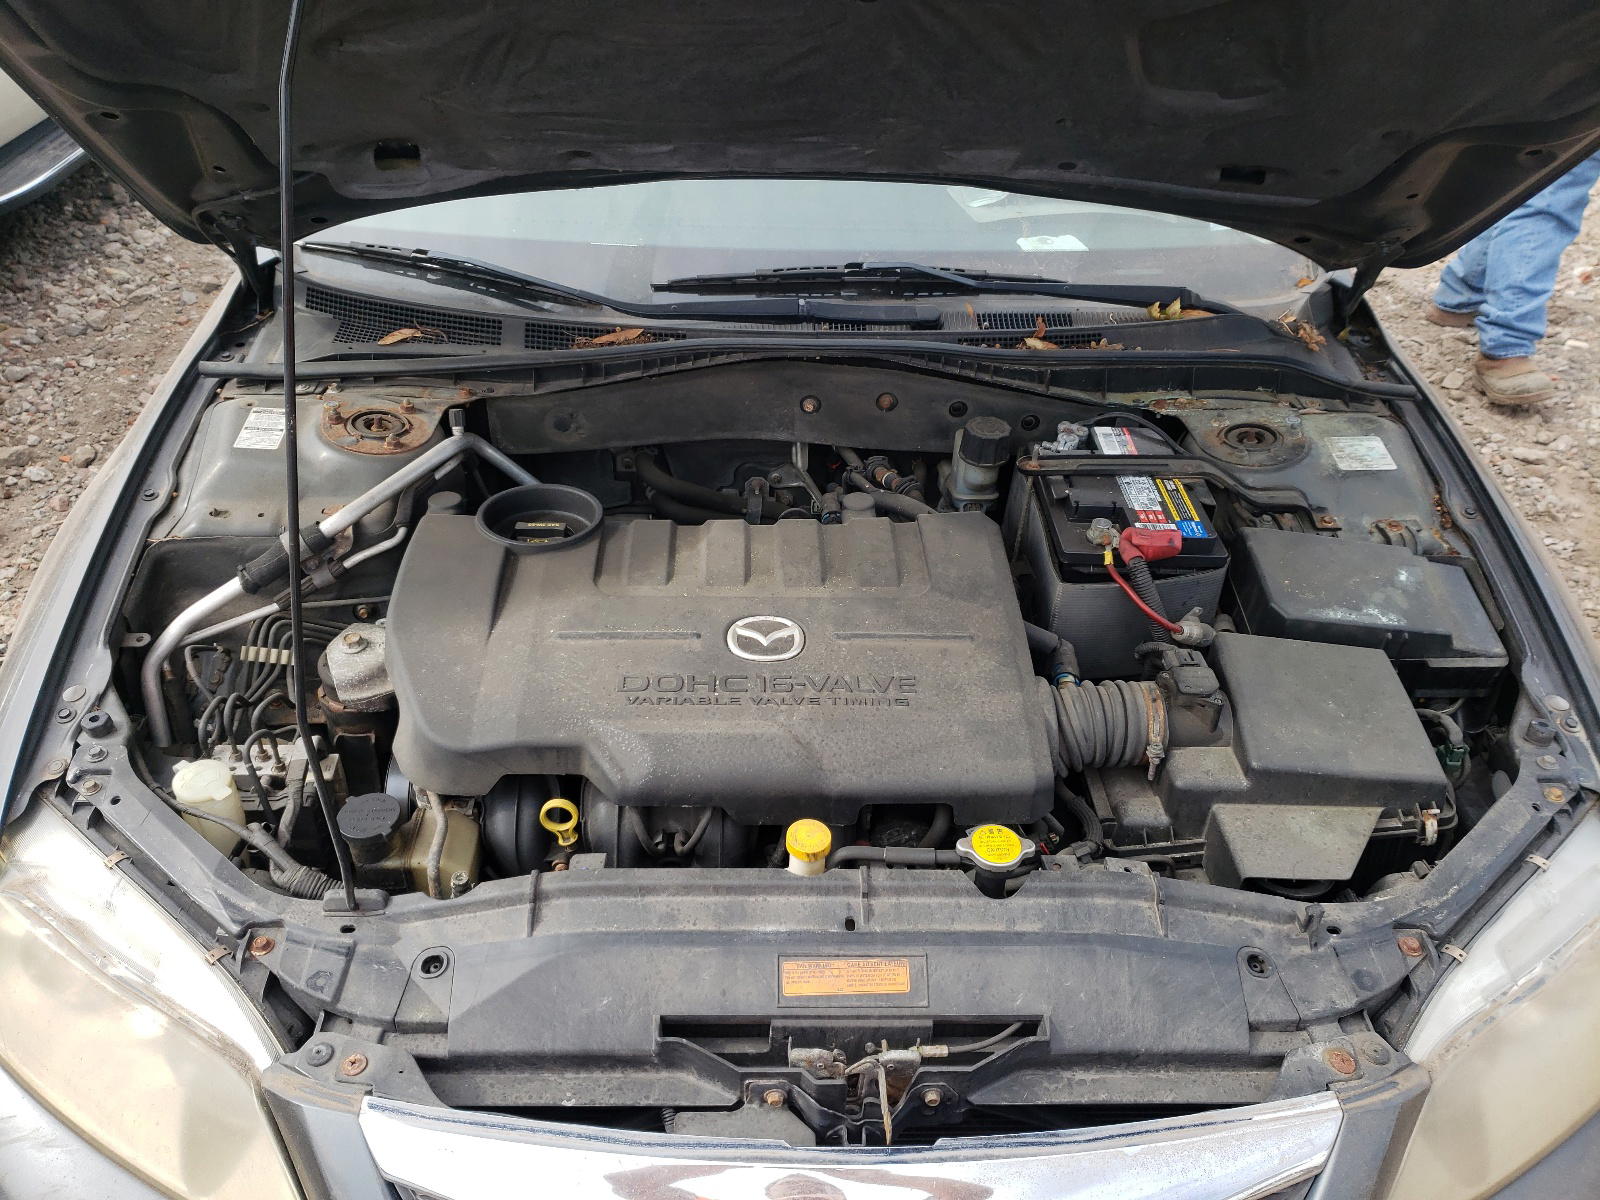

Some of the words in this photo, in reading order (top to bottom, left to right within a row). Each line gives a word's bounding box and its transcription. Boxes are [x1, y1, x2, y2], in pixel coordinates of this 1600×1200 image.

[617, 673, 749, 694] DOHC
[758, 675, 918, 694] 16-VALVE
[626, 696, 741, 706] VARIABLE
[749, 696, 821, 706] VALVE
[827, 697, 910, 707] TIMING
